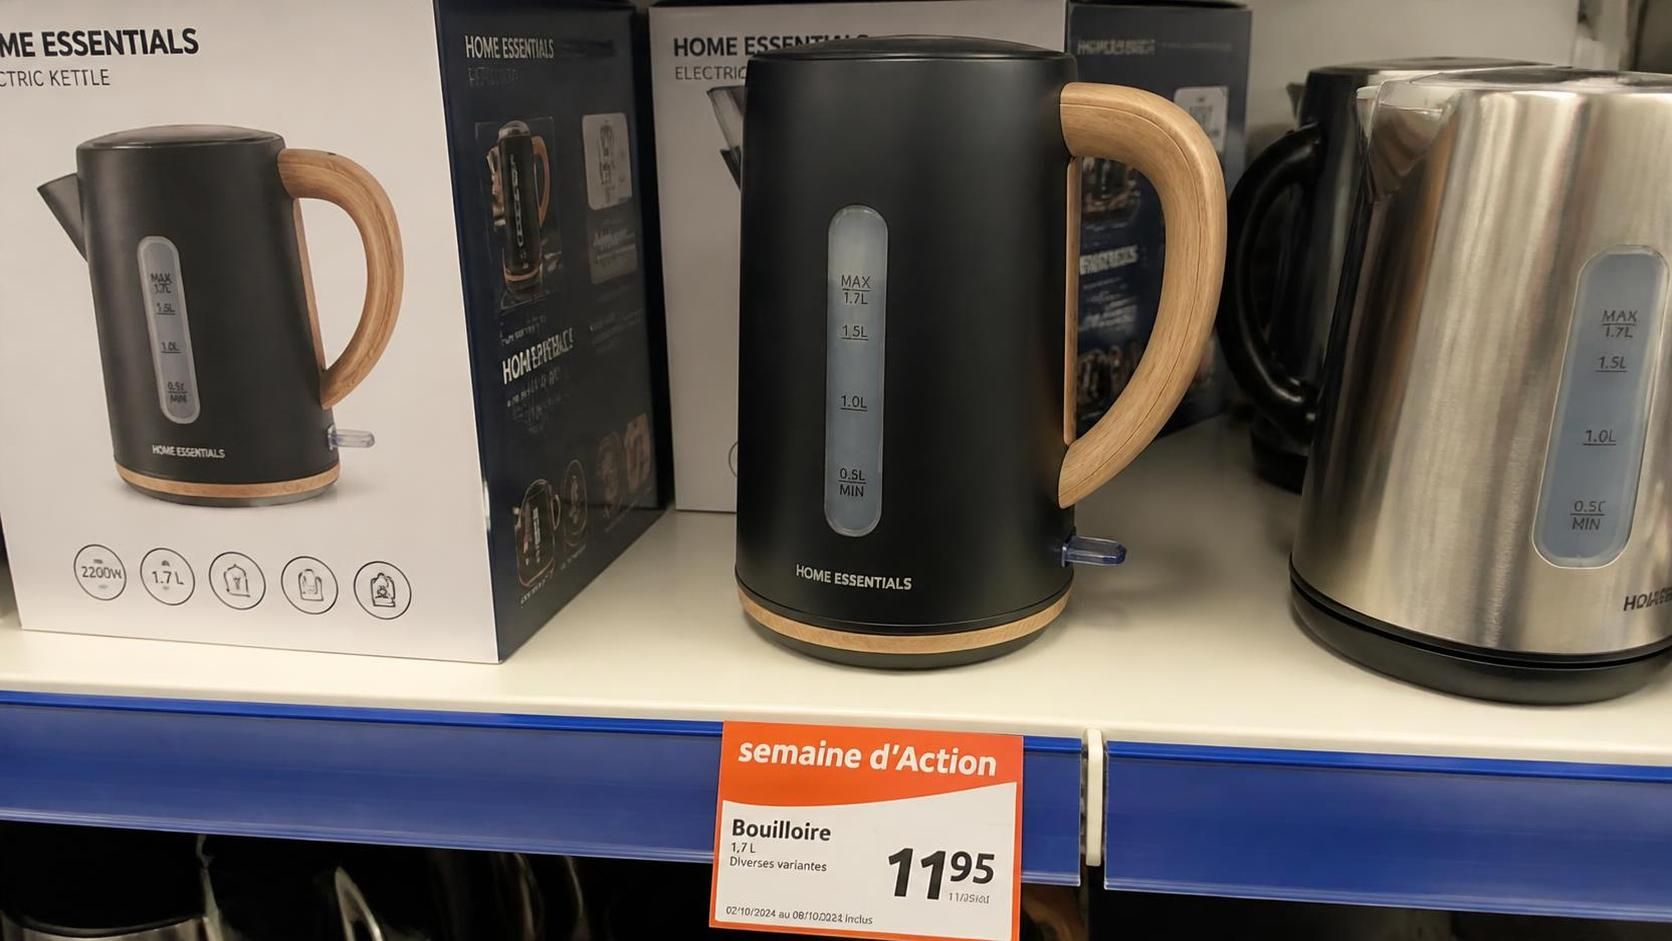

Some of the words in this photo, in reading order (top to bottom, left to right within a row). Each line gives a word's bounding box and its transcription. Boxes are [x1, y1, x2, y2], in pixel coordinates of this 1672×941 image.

[41, 28, 199, 57] ESSENTIALS
[465, 35, 500, 59] HOME
[502, 37, 554, 59] ESSENTIALS
[673, 37, 738, 57] HOME
[49, 68, 111, 86] KETTLE
[675, 65, 747, 81] ELECTRIC
[841, 274, 871, 289] MAX
[844, 291, 869, 305] 1.7L
[1602, 310, 1638, 322] MAX
[1605, 326, 1633, 339] 1.7L
[1598, 356, 1627, 369] 1.5L
[841, 394, 868, 409] 1.0L
[1585, 429, 1617, 443] 1.0L
[839, 484, 865, 498] MIN
[1571, 516, 1601, 531] MIN
[796, 563, 832, 584] HOME
[833, 571, 913, 591] ESSENTIALS
[737, 740, 862, 768] semaine
[731, 818, 832, 842] Bouilloire
[729, 856, 775, 869] Diverses
[777, 860, 828, 873] variantes
[778, 911, 790, 920] au
